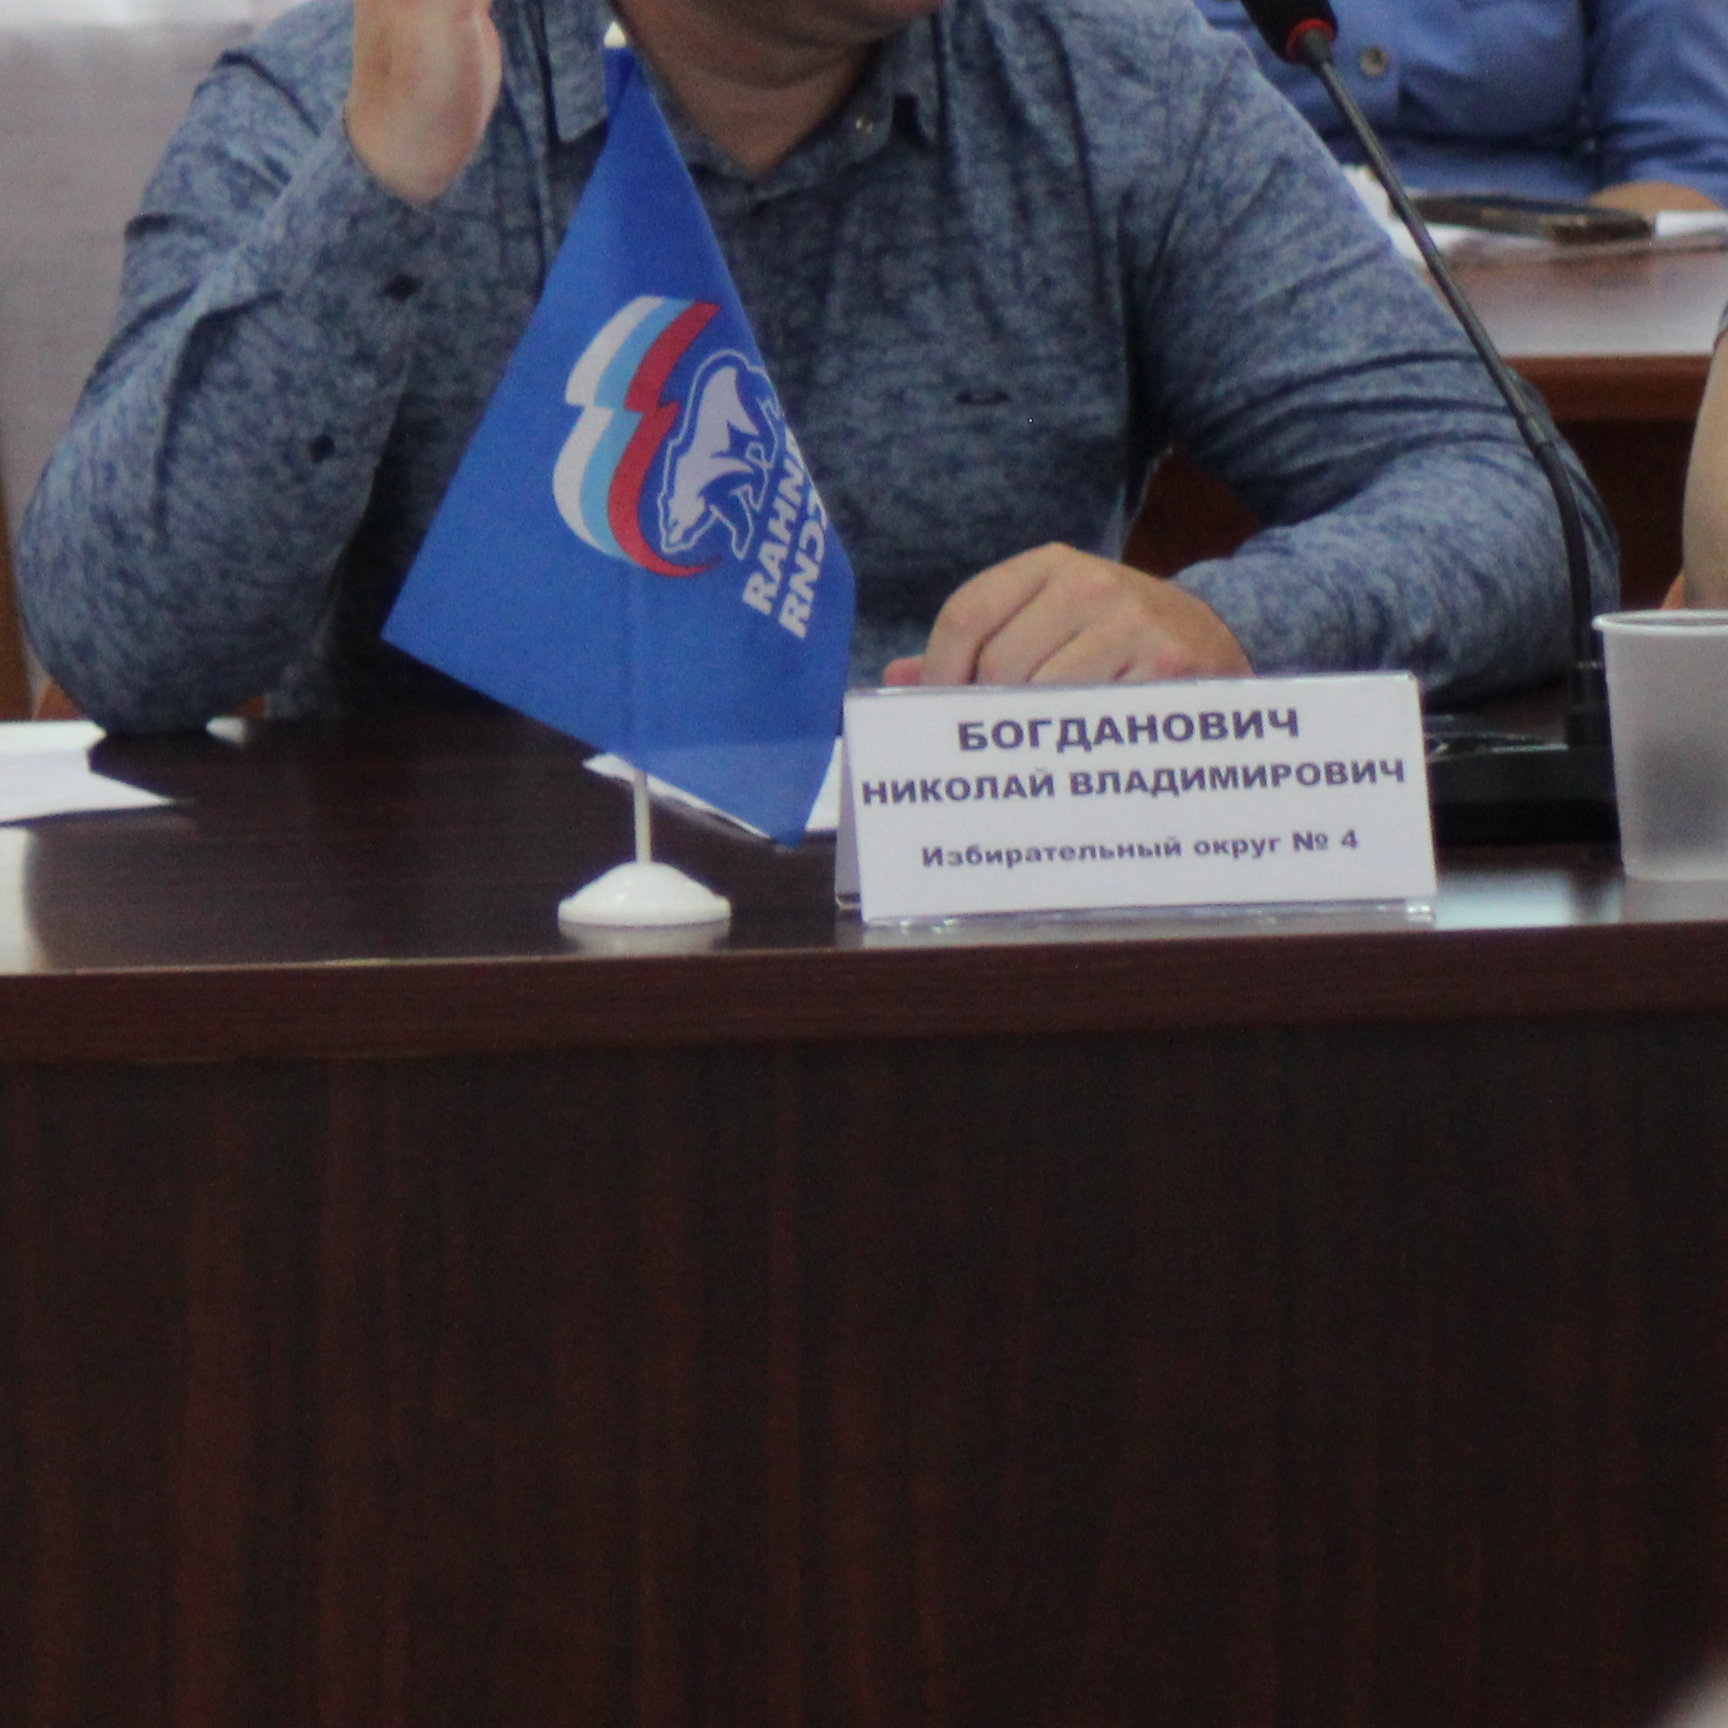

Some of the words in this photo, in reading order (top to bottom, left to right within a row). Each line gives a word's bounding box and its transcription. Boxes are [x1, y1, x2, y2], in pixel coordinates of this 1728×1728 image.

[957, 708, 1299, 754] БОГДАНОВИЧ
[861, 765, 1055, 806] НИКОЛАЙ
[1069, 758, 1405, 798] ВЛАДИМИРОВИЧ
[921, 836, 1182, 870] Избирательный
[1193, 837, 1282, 860] округ
[1292, 831, 1329, 852] №
[1339, 828, 1359, 850] 4
